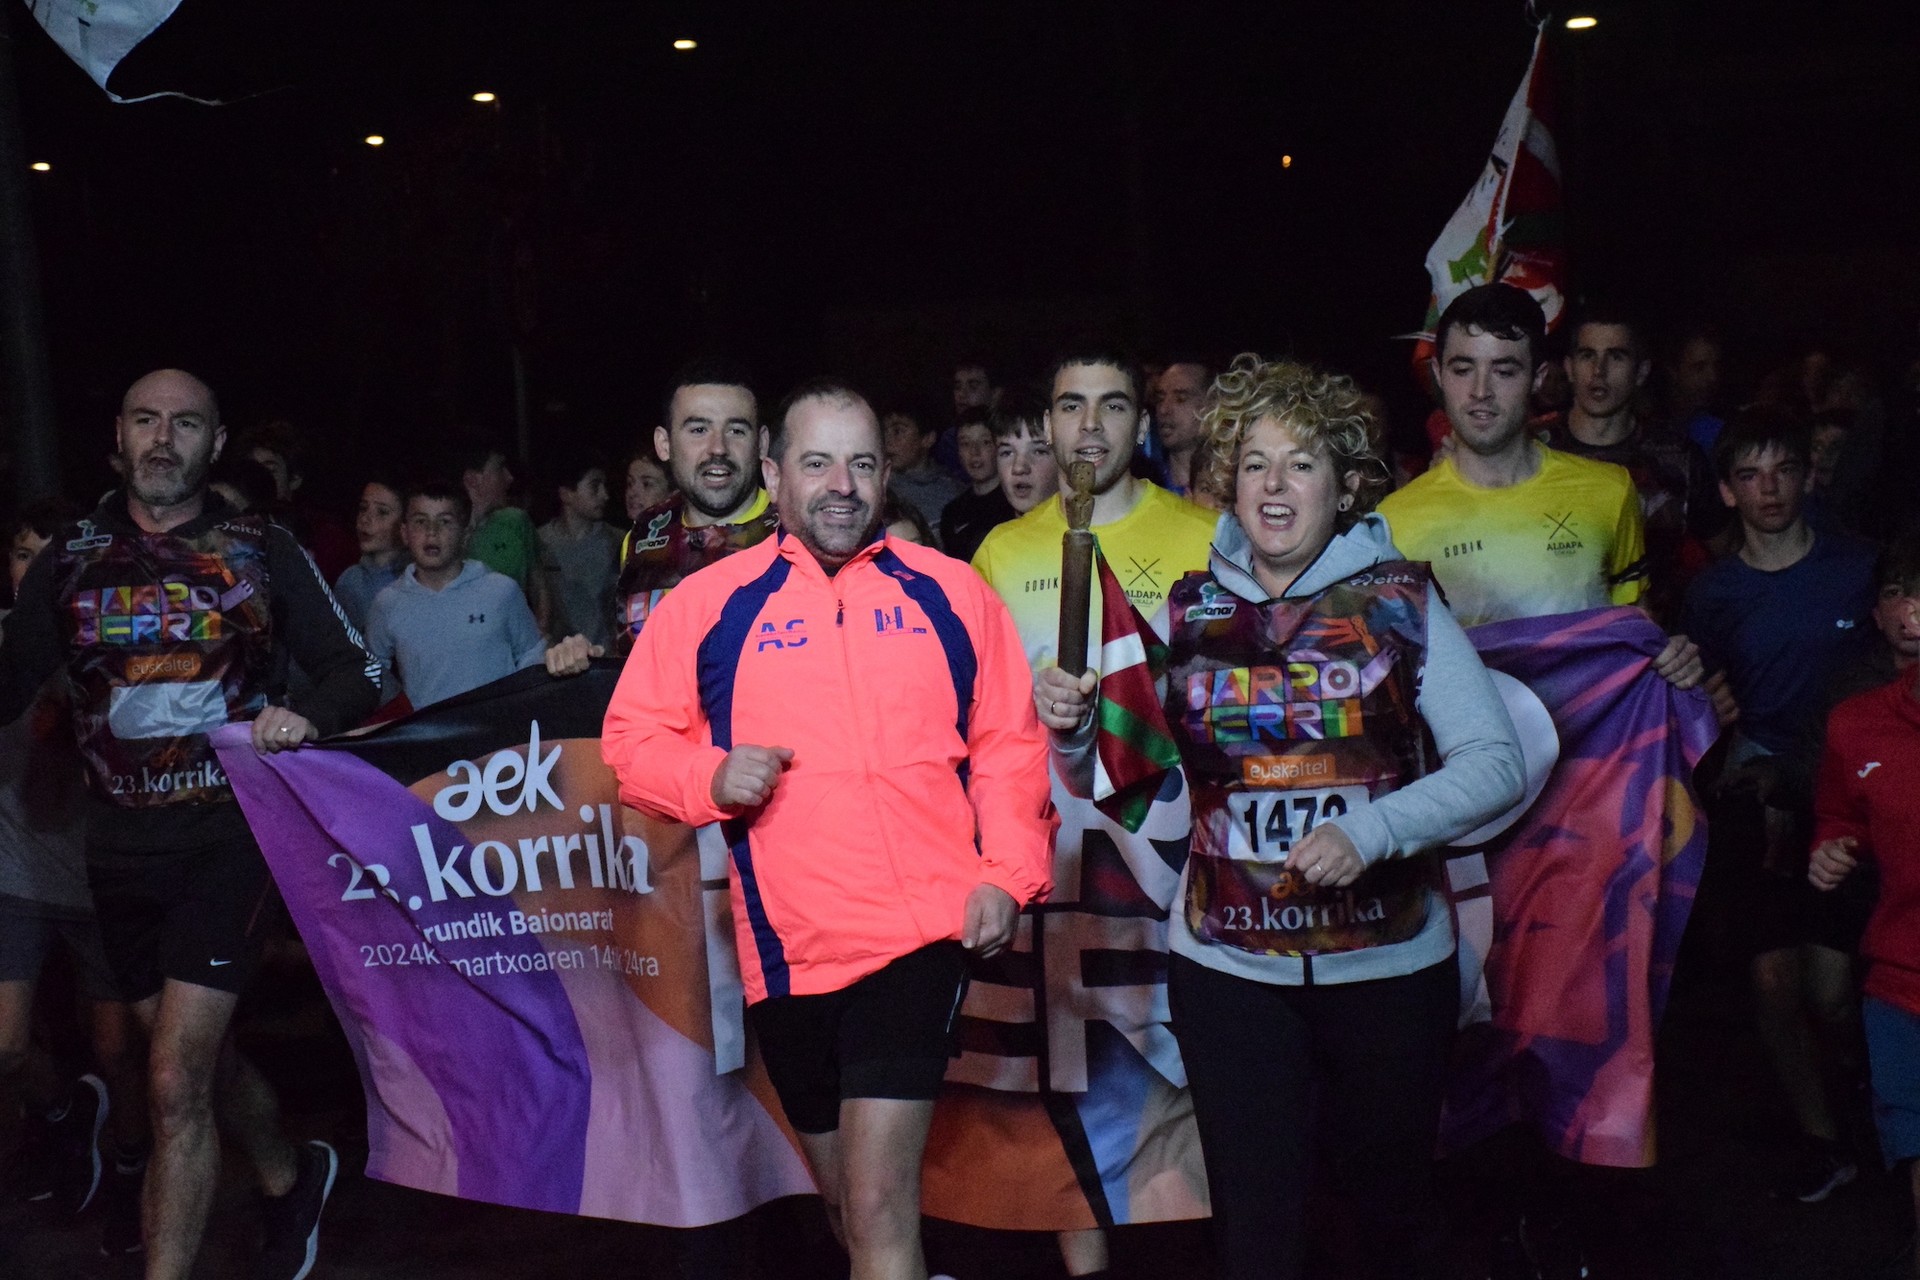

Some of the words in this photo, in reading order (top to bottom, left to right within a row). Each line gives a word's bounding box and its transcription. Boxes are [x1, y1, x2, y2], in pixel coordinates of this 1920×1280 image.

[1444, 540, 1483, 558] GOBIK
[1547, 541, 1583, 551] ALDAPA
[1025, 577, 1059, 593] GOBIK
[1125, 589, 1163, 600] ALDAPA
[131, 657, 195, 675] euskaltel
[433, 719, 565, 823] aek
[1250, 759, 1328, 780] euskaltel
[1223, 889, 1386, 931] 23.korrika
[415, 911, 506, 944] rundik
[508, 907, 614, 935] Baionarat
[360, 941, 441, 968] 2024k
